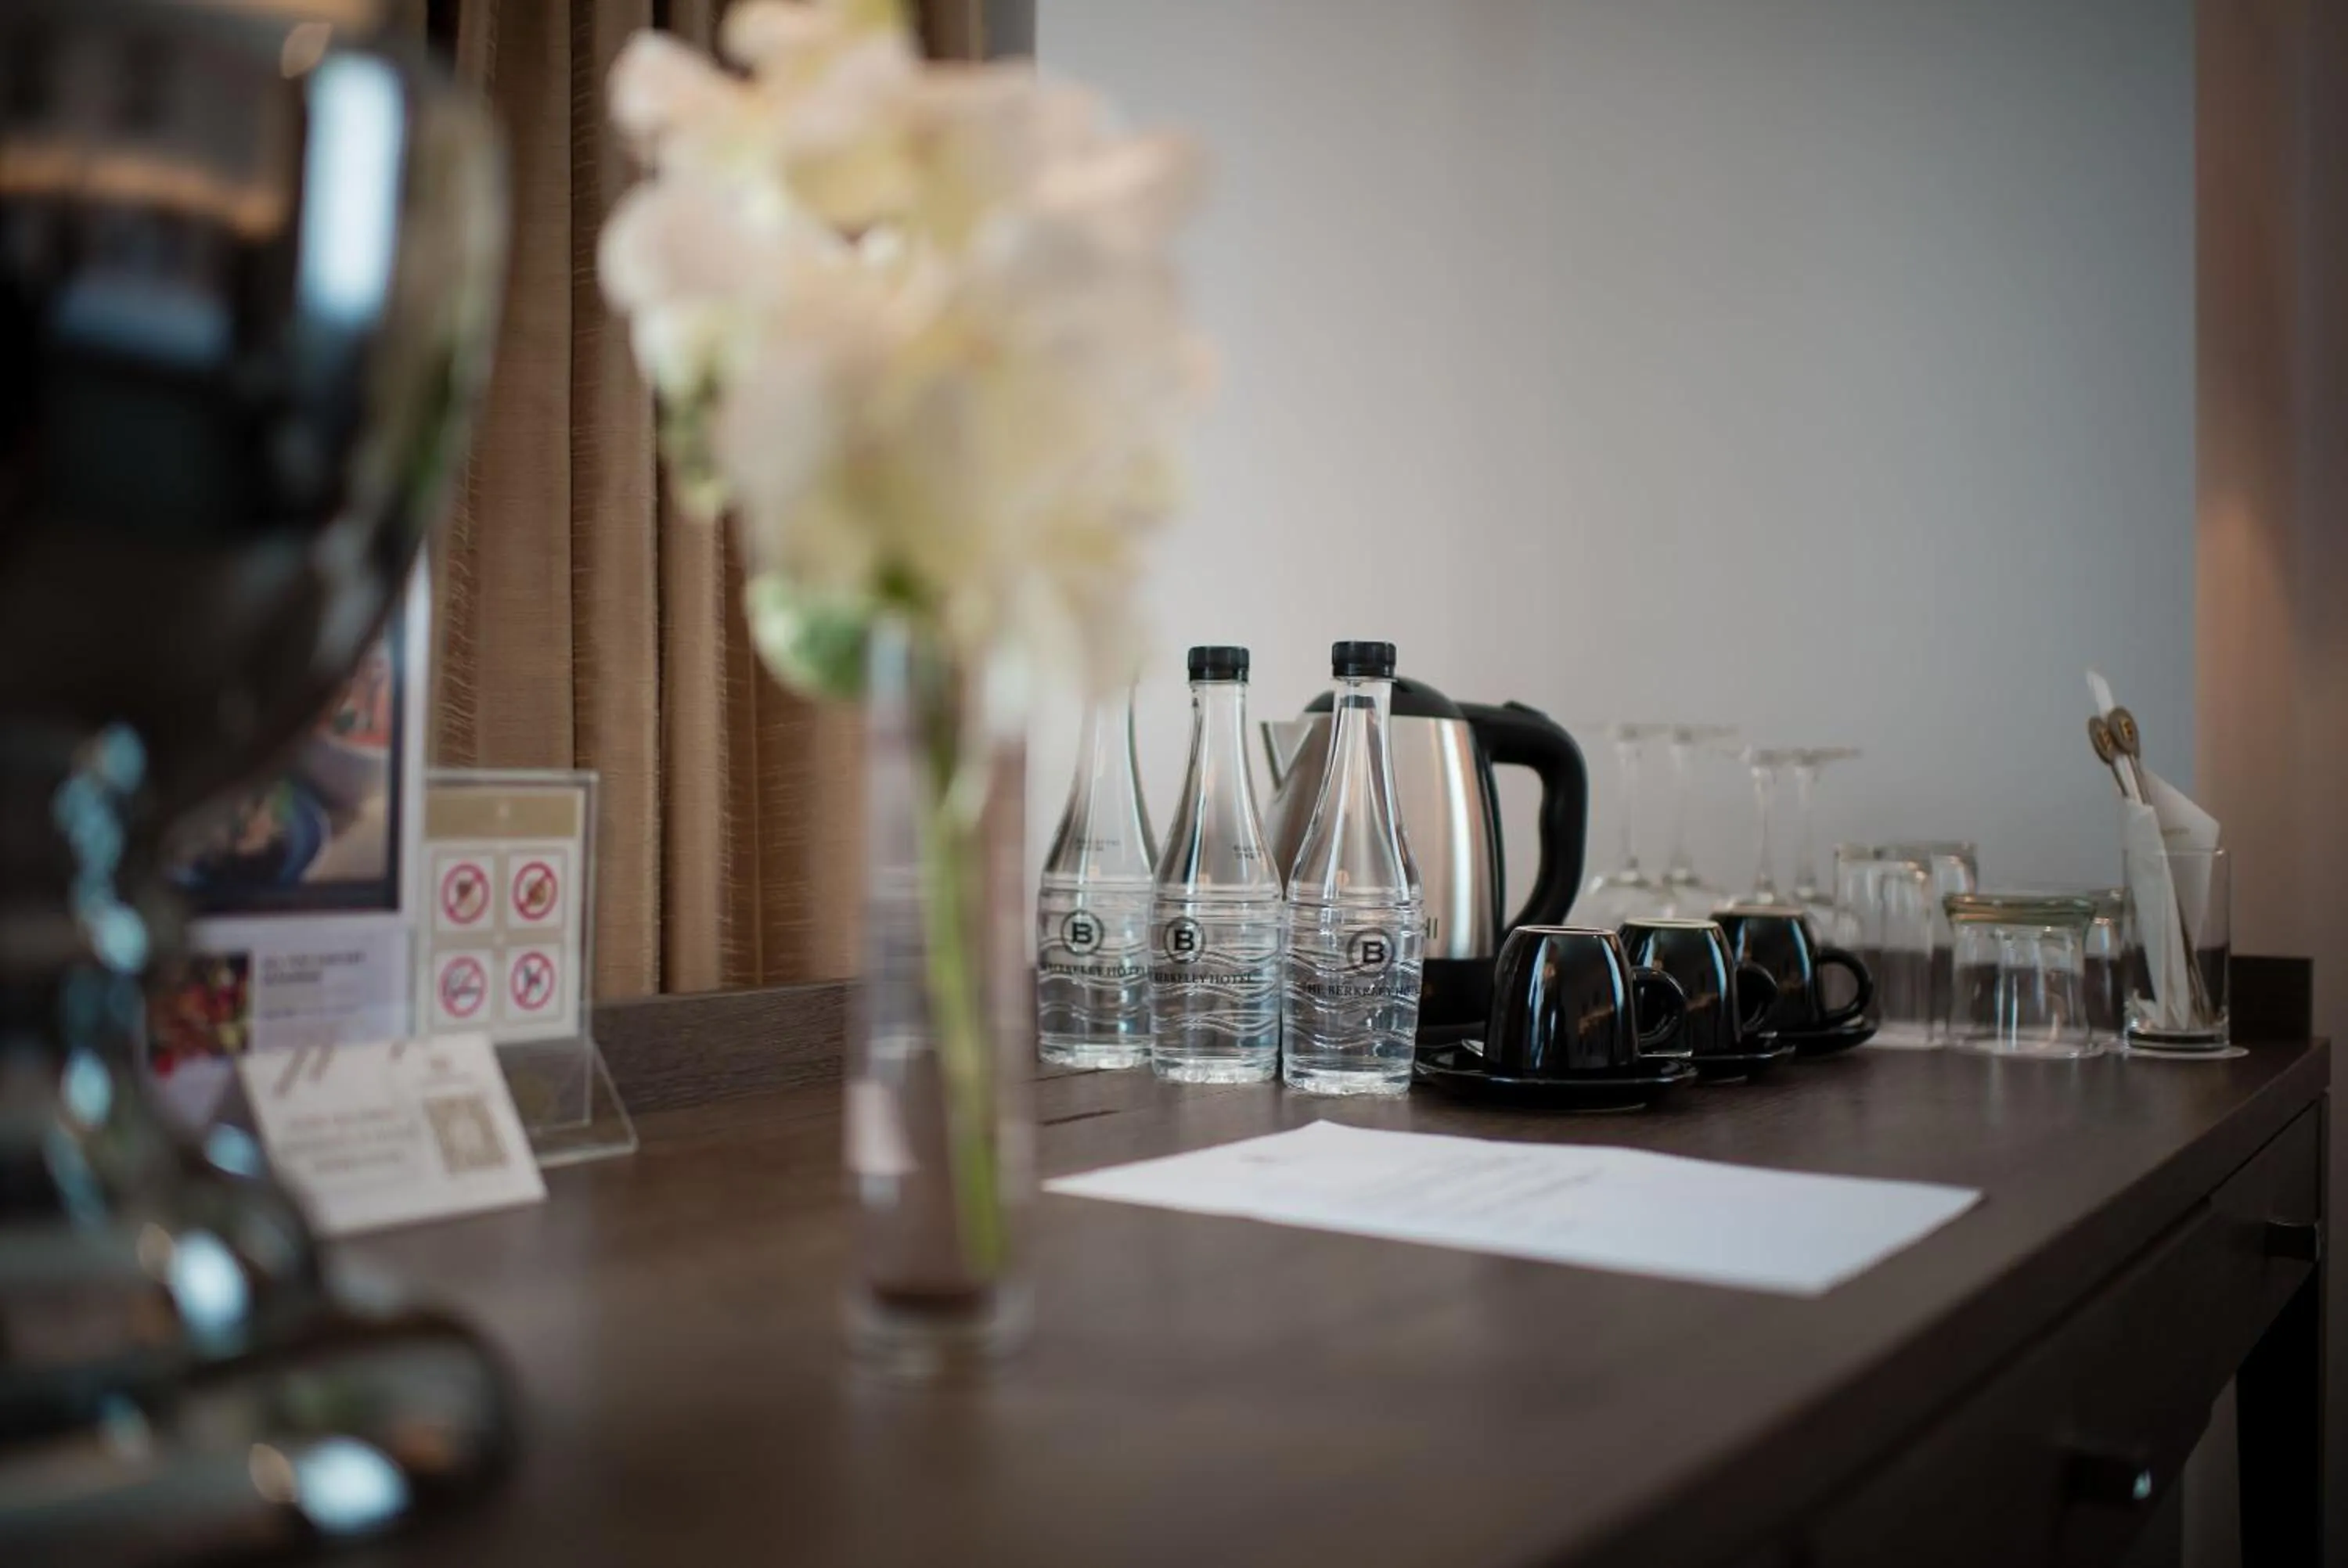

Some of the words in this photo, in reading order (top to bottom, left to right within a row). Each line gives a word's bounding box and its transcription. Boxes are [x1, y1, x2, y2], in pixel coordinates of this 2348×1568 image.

[1071, 922, 1093, 944] B
[1174, 930, 1194, 951] B
[1362, 941, 1385, 963] B
